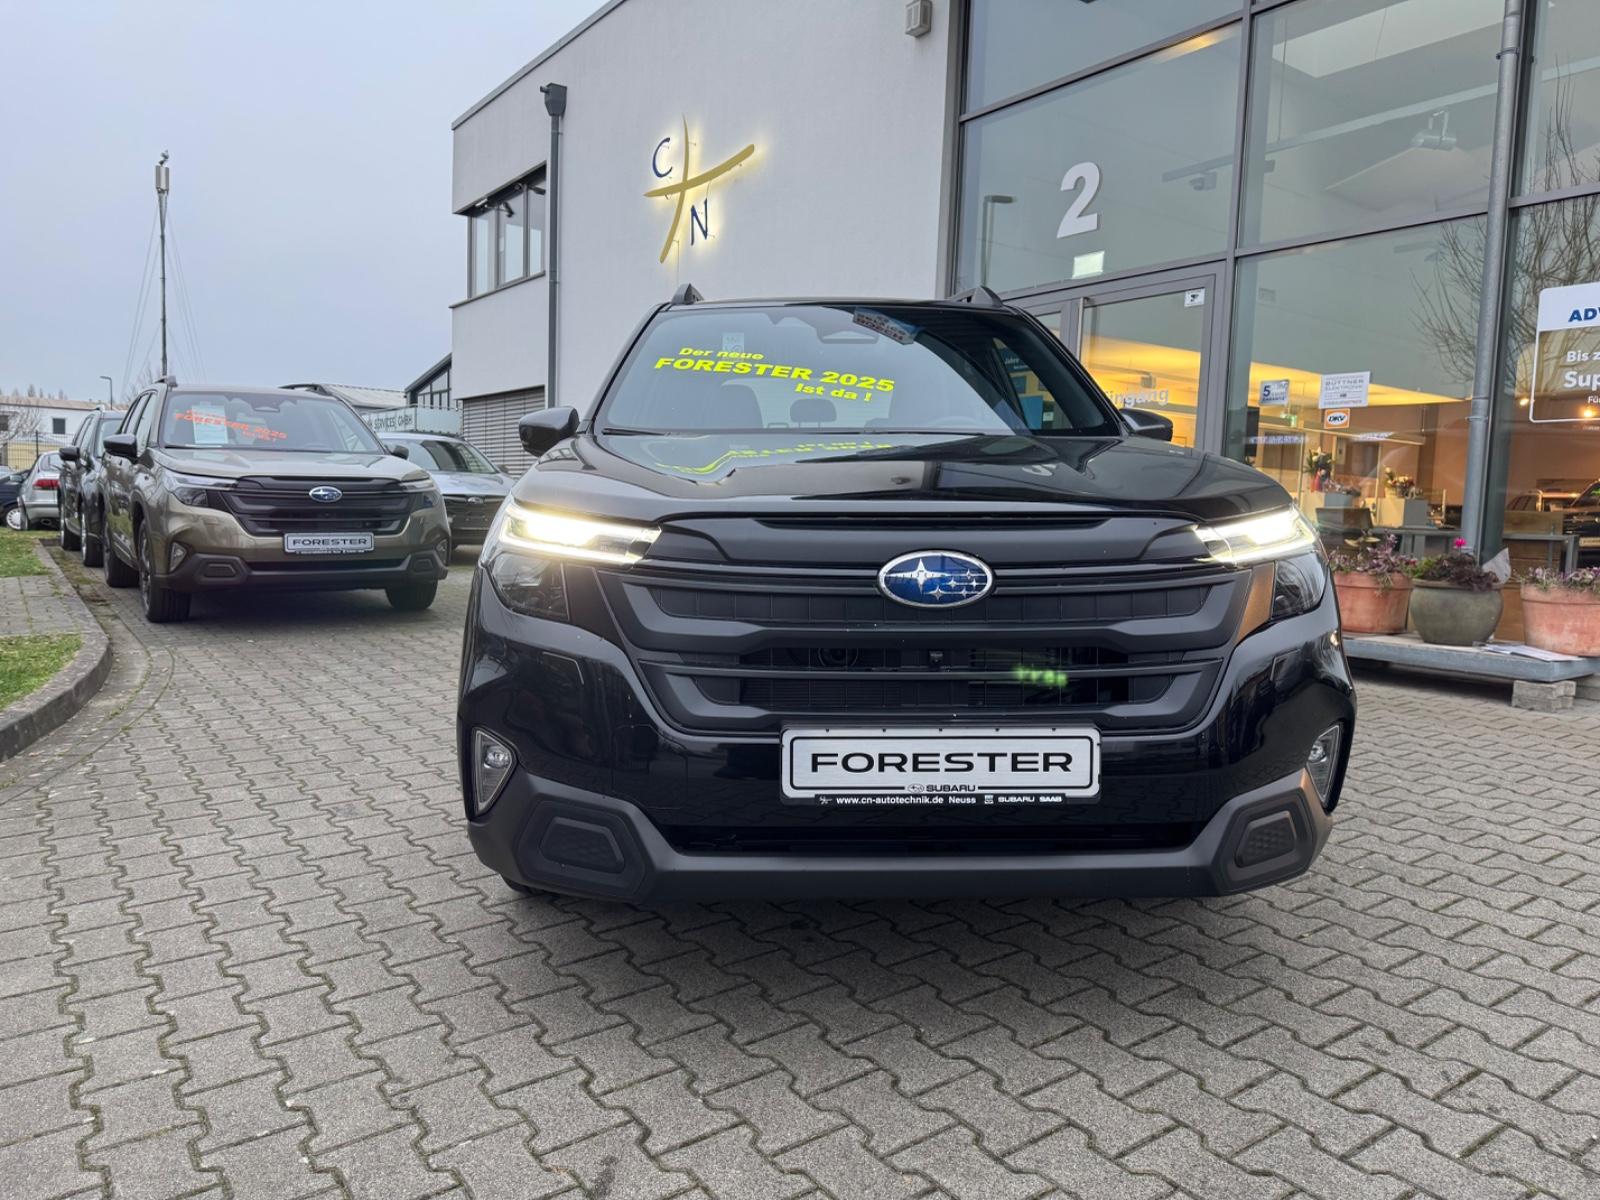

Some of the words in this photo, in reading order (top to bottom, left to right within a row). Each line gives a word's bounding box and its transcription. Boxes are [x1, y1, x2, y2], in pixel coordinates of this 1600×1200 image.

[652, 137, 673, 178] C
[1057, 161, 1100, 239] 2
[690, 198, 708, 246] N
[1568, 307, 1600, 322] AD
[678, 347, 713, 357] Der
[717, 350, 765, 360] neue
[1566, 350, 1589, 362] Bis
[654, 357, 814, 381] FORESTER
[820, 371, 896, 392] 2025
[795, 383, 826, 396] Ist
[831, 389, 858, 401] da
[864, 392, 873, 402] !
[1105, 389, 1169, 408] ingang
[1263, 385, 1271, 397] 5
[1328, 415, 1346, 424] DKV
[292, 538, 367, 546] FORESTER
[811, 752, 1073, 773] FORESTER
[926, 784, 976, 792] SUBARU
[837, 795, 944, 804] www.cn-autotechnik.de
[949, 796, 977, 804] Neuss
